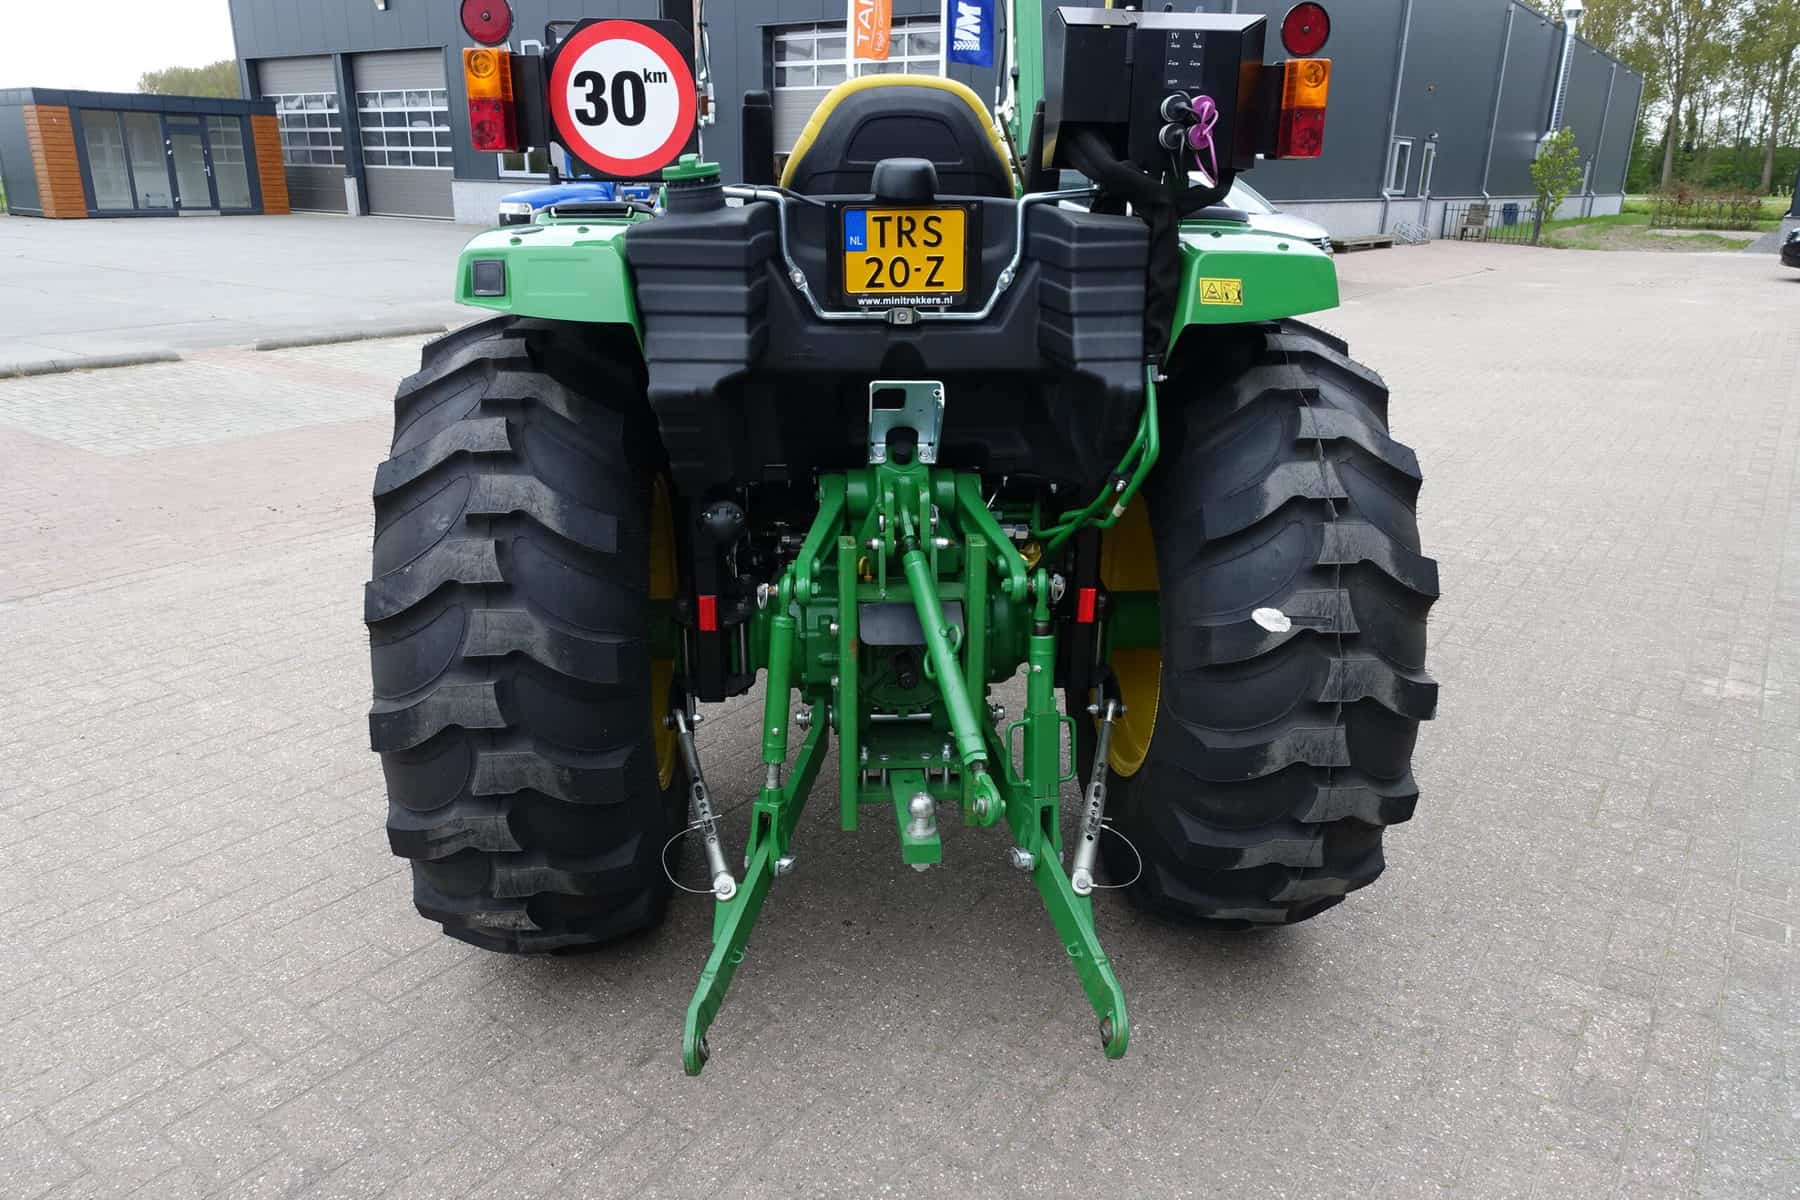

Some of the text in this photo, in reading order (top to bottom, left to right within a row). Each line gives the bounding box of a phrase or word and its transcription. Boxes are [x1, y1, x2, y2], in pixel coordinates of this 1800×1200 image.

[573, 68, 668, 127] 30 km
[849, 236, 863, 246] NL
[872, 215, 943, 248] TRS
[865, 256, 944, 288] 20-Z
